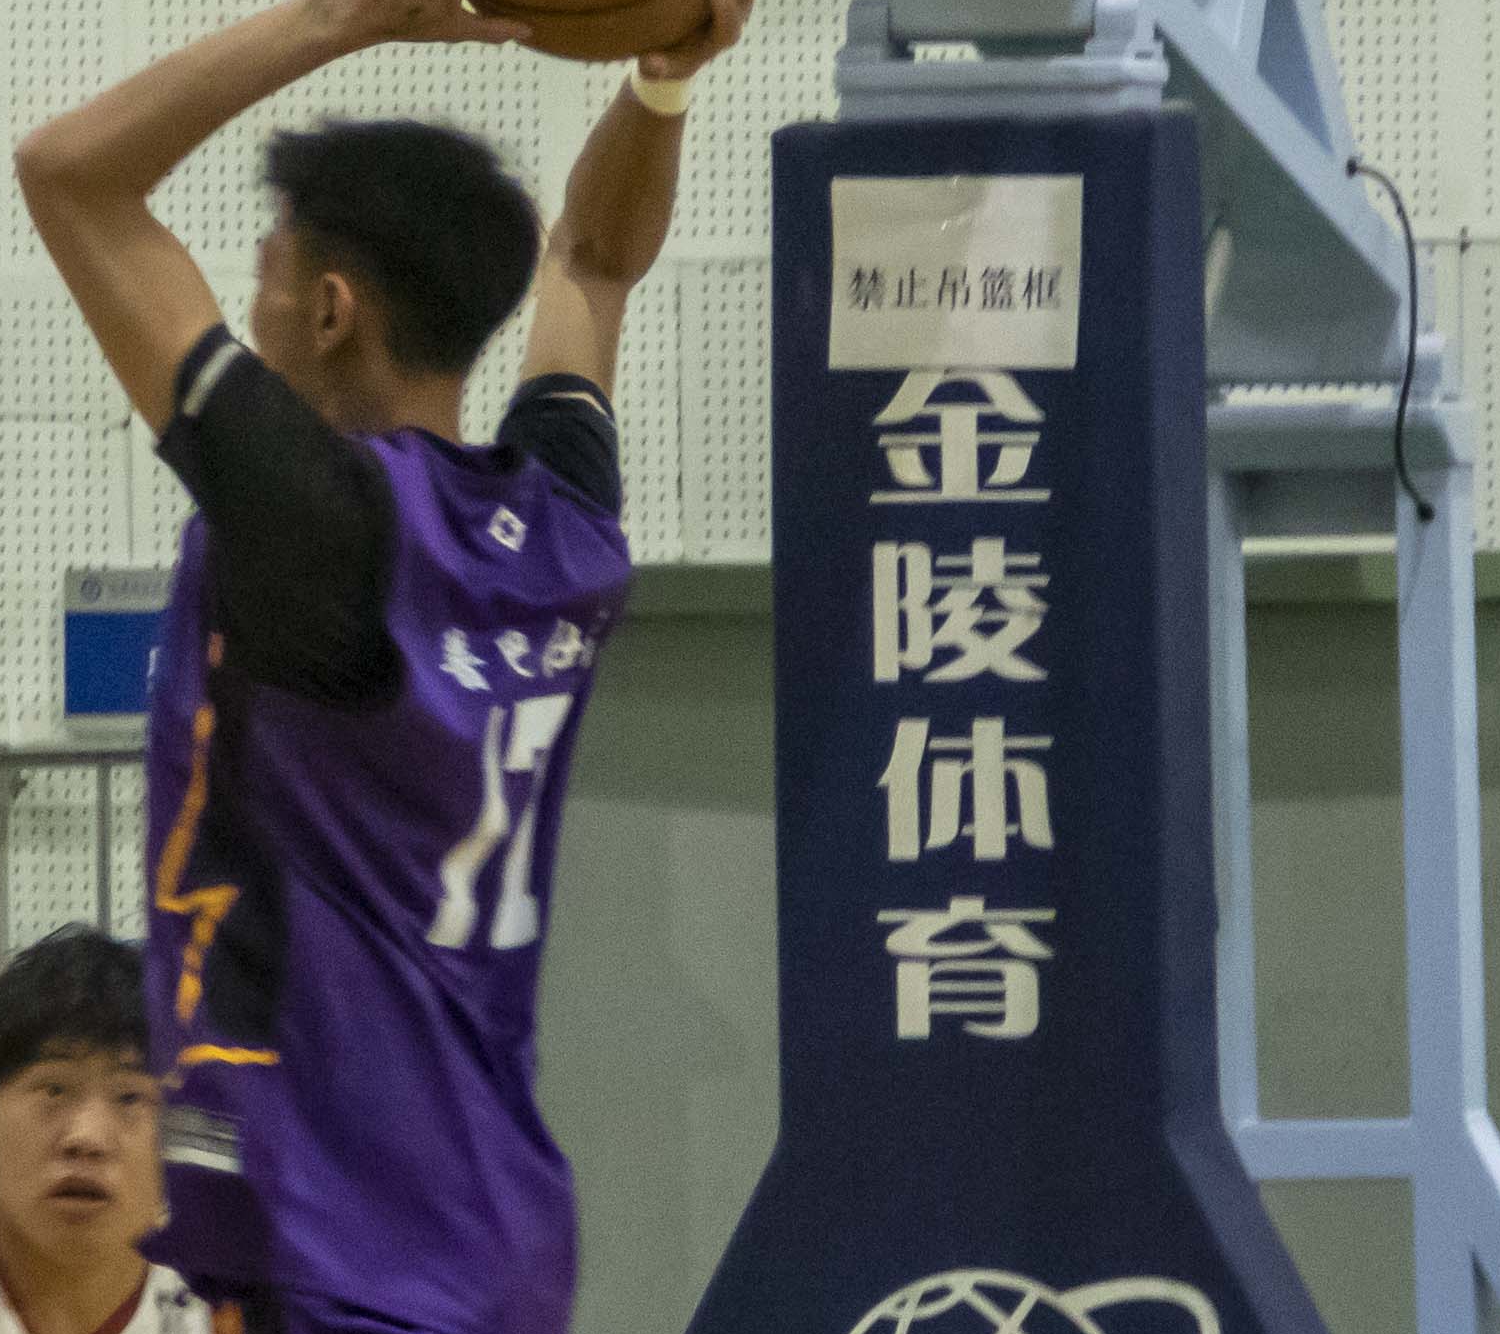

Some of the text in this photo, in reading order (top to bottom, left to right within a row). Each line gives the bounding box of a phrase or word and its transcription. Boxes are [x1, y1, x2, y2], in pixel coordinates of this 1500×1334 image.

[847, 266, 1063, 312] 禁止吊篮框
[869, 369, 1056, 1041] 金陵体育
